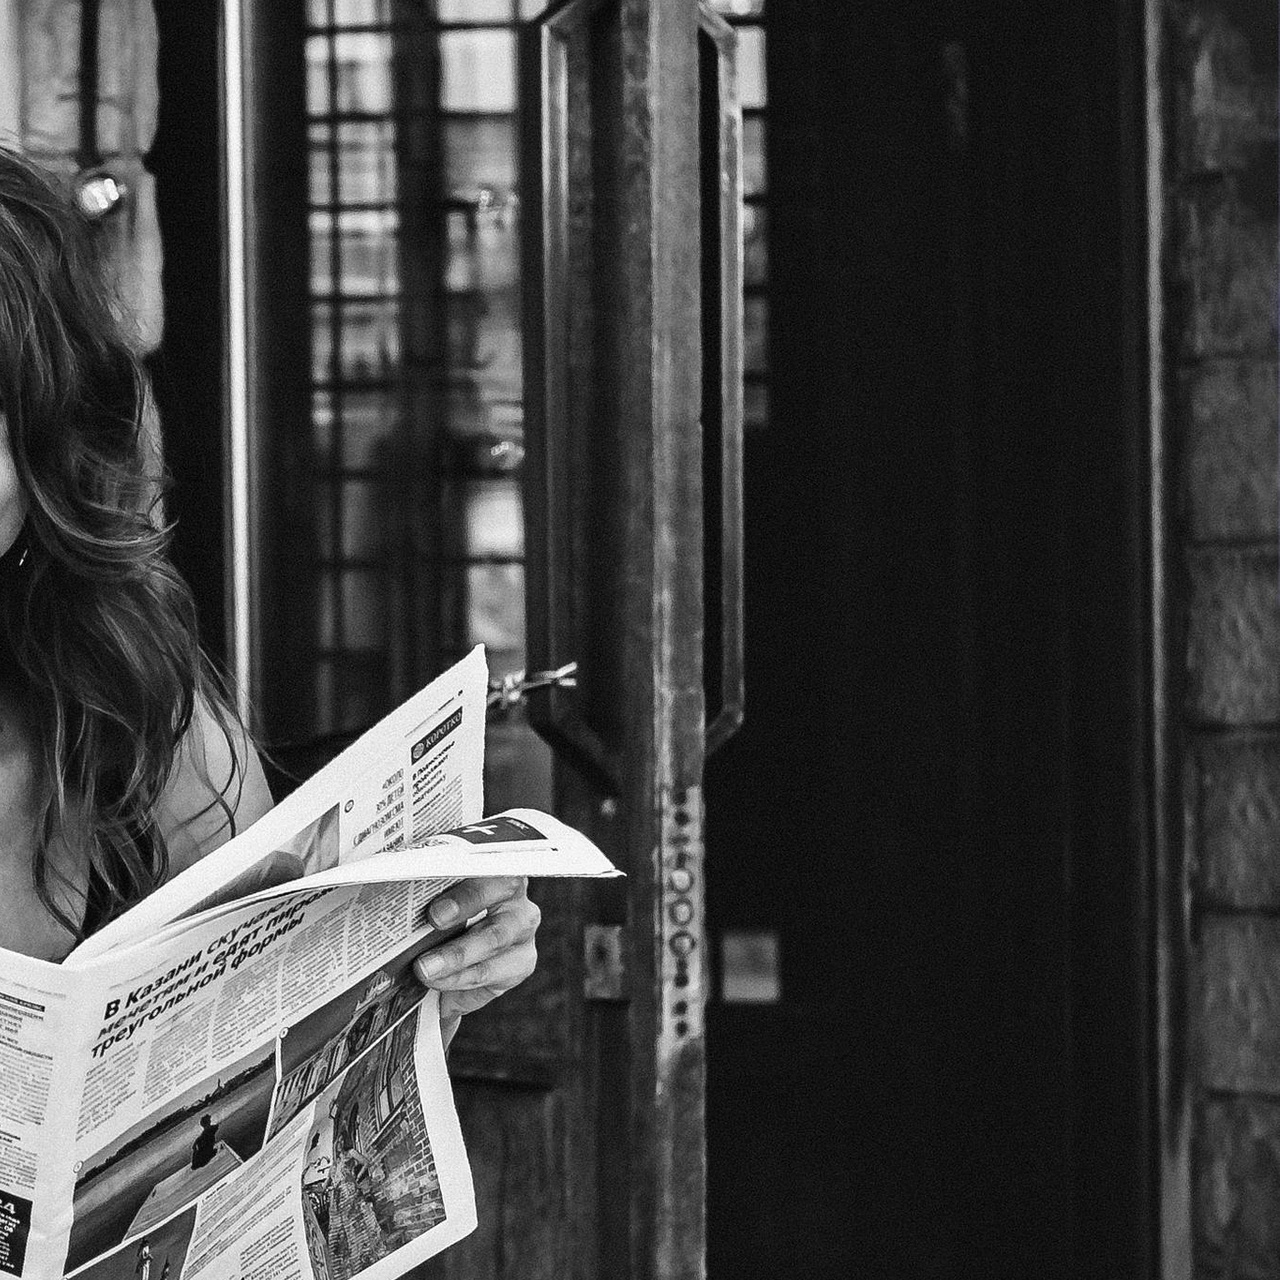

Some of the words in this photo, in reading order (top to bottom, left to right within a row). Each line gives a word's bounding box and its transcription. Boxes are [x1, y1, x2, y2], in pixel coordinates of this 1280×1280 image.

[91, 956, 227, 1059] треугольной
[230, 912, 306, 971] формы
[97, 973, 190, 1041] мечетям
[192, 962, 209, 979] и
[213, 926, 263, 967] едят
[104, 998, 121, 1021] В
[124, 951, 204, 1009] Казани
[207, 894, 298, 955] скучают
